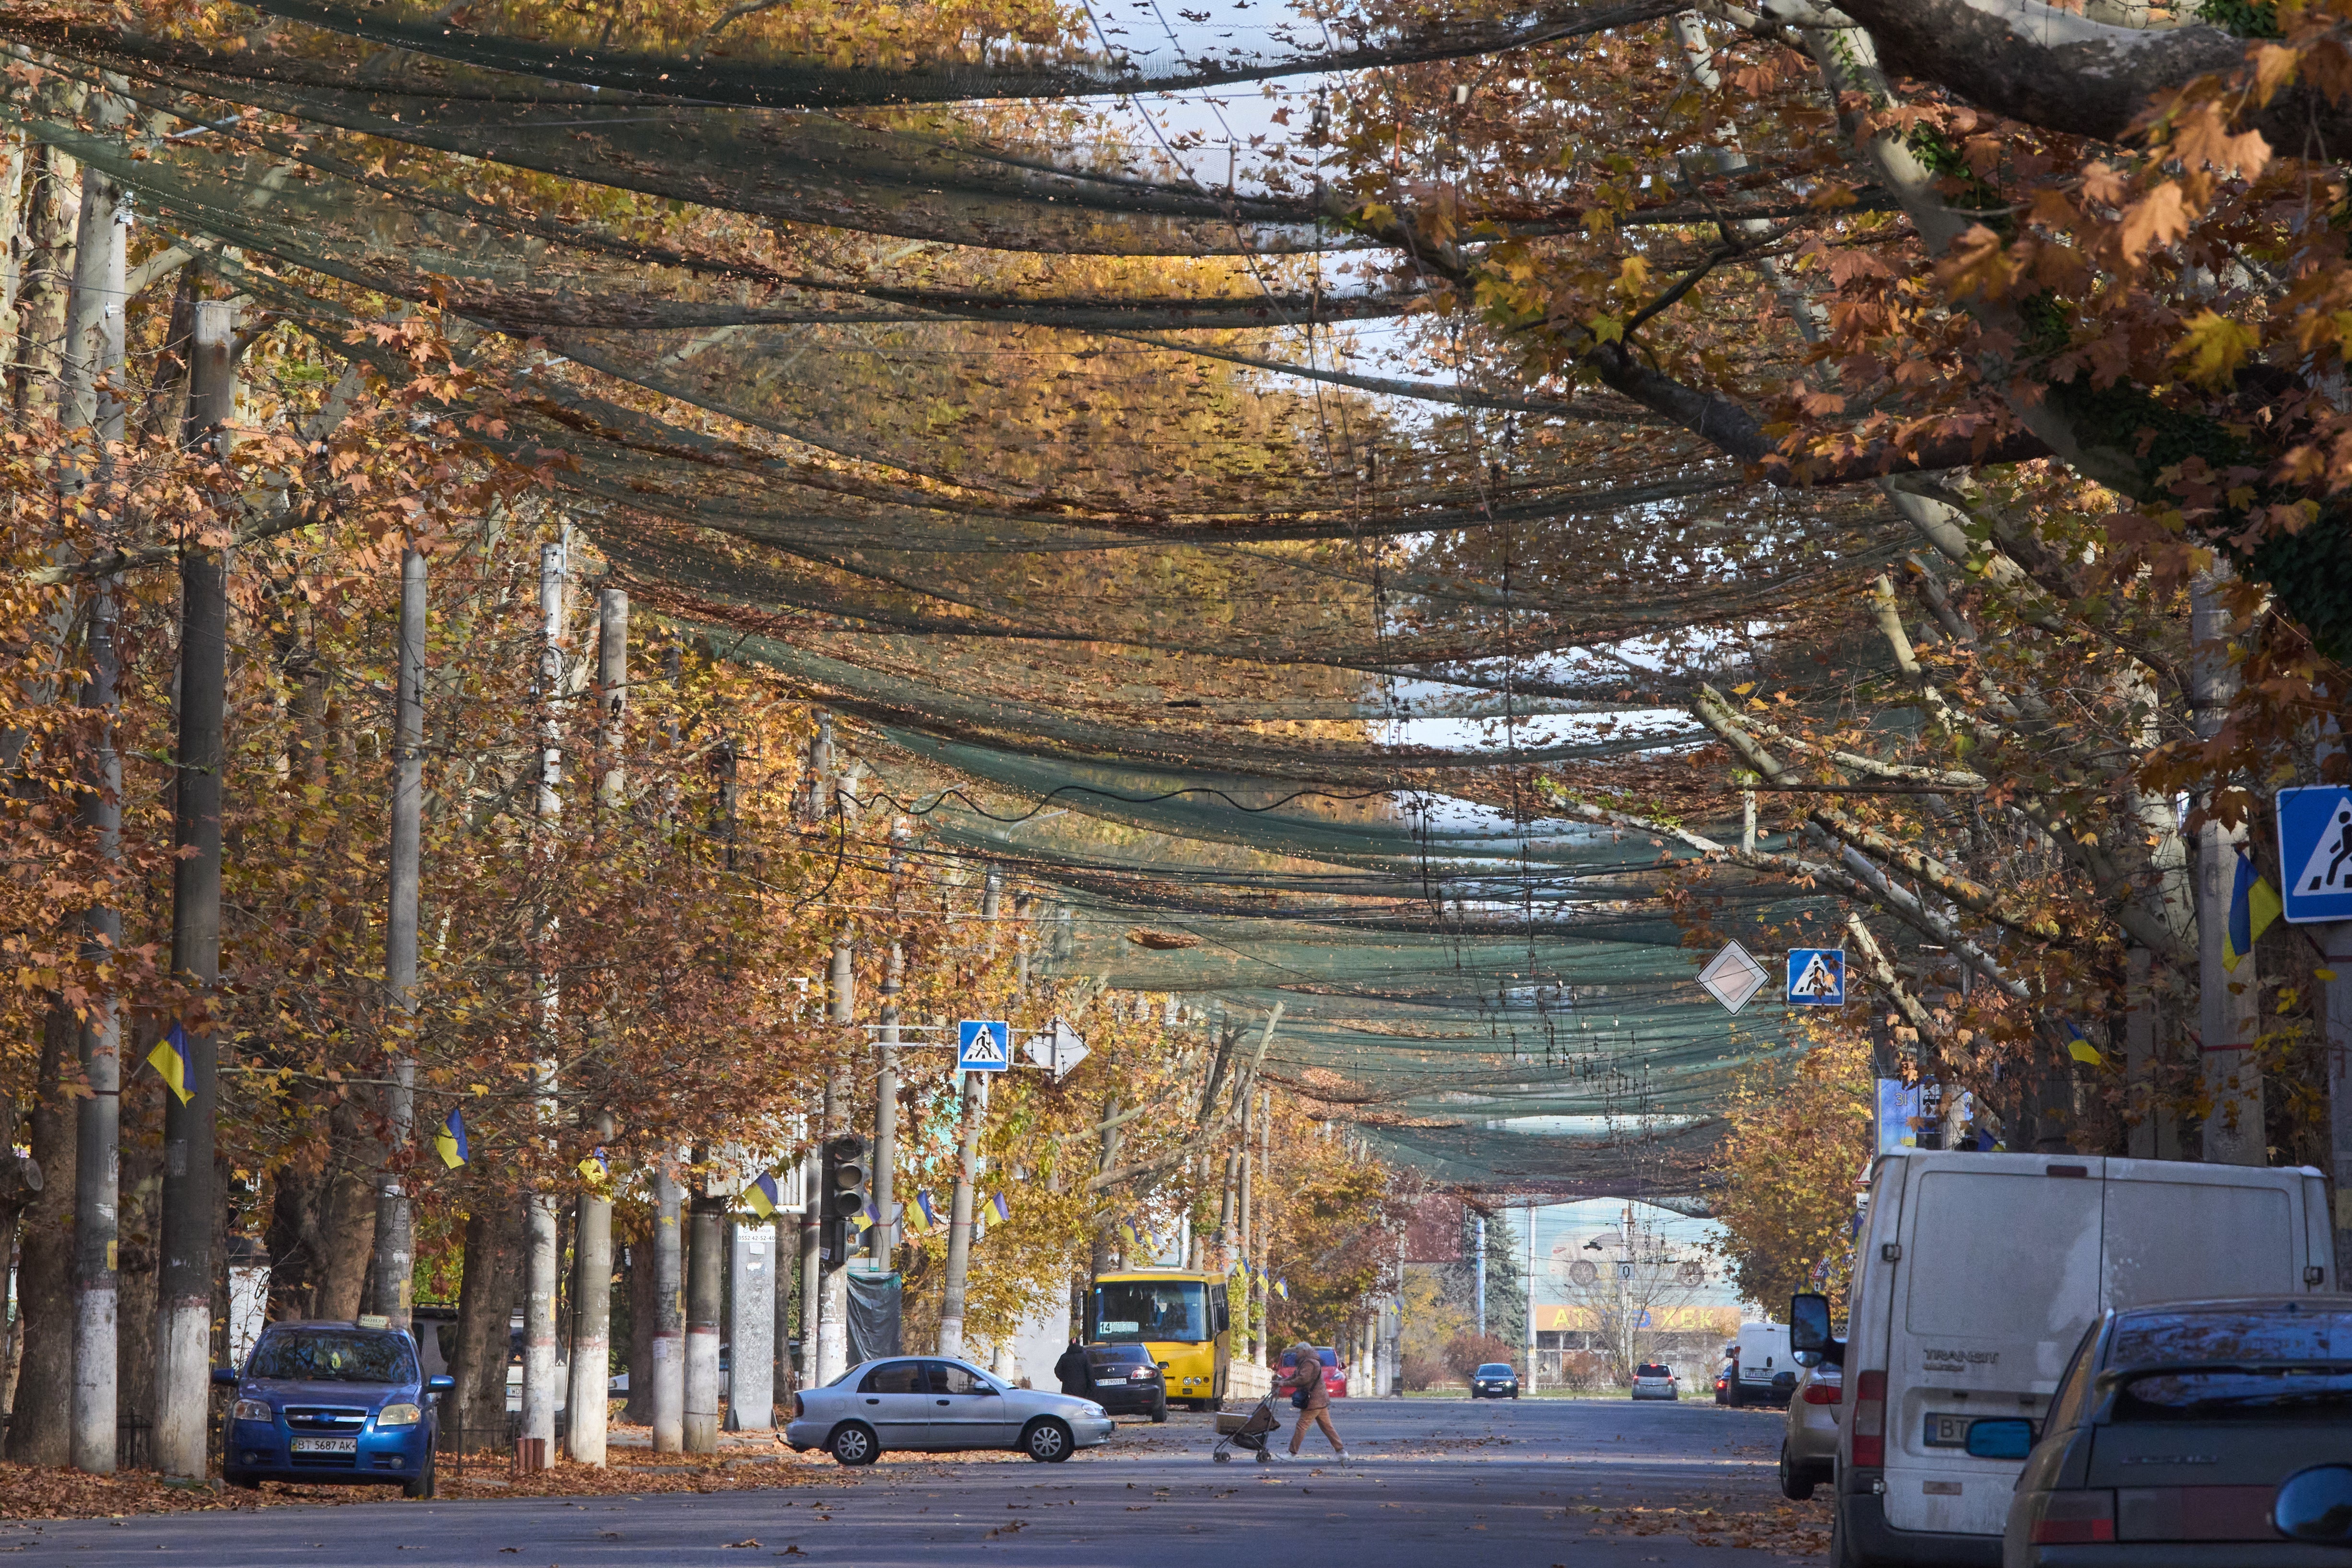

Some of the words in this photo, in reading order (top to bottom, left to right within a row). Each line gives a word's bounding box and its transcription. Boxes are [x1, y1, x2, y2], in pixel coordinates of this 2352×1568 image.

[1660, 1309, 1714, 1329] ХБК
[1100, 1323, 1111, 1332] 14
[1923, 1348, 1999, 1363] TRANSIT
[1940, 1419, 1967, 1438] BT
[298, 1440, 312, 1450] BT
[315, 1440, 336, 1450] 5687
[339, 1441, 352, 1451] AK
